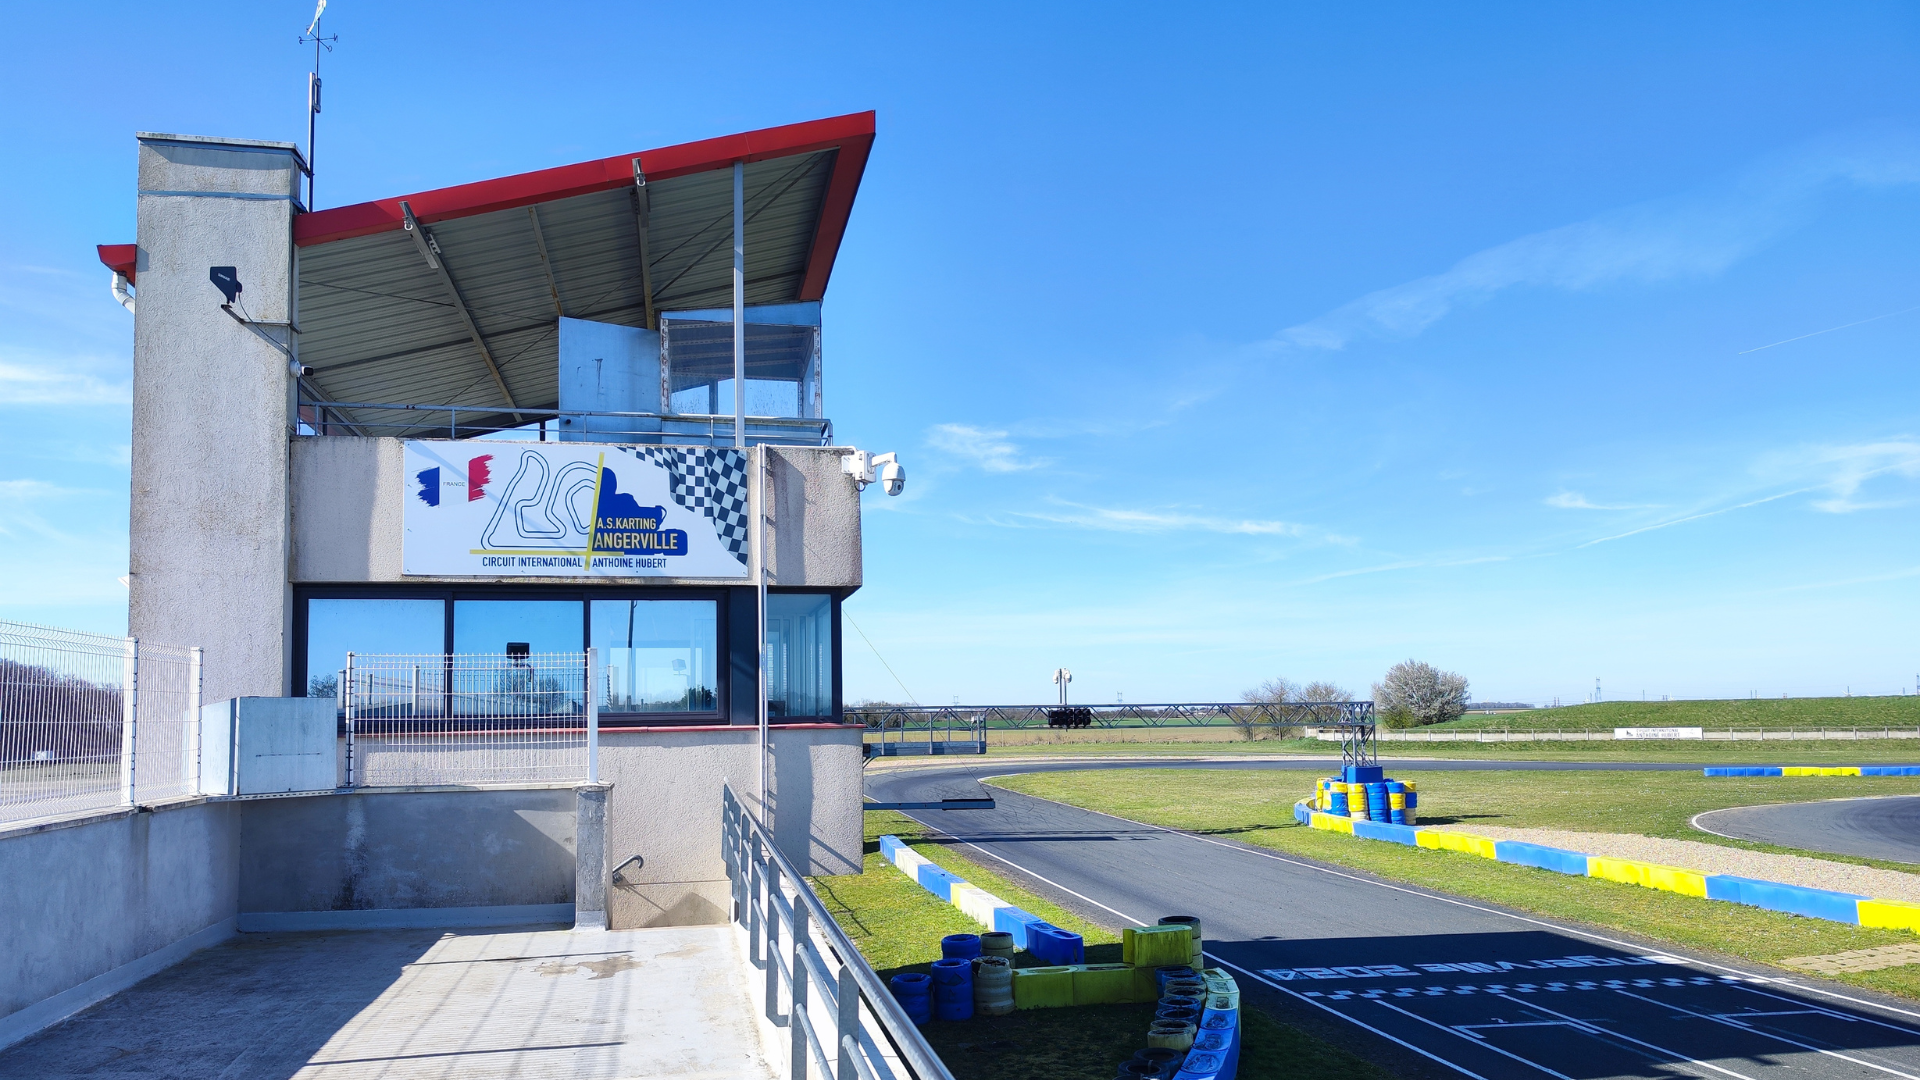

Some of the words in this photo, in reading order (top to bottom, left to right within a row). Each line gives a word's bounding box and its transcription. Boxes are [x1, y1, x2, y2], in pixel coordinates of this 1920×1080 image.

[442, 480, 466, 488] FRANCE
[597, 517, 656, 530] A.S.KARTING
[594, 532, 678, 549] ANGERVILLE
[482, 557, 515, 568] CIRCUIT
[517, 557, 582, 568] INTERNATIONAL
[592, 558, 634, 568] ANTHOINE
[635, 558, 667, 568] HUBERT
[1255, 964, 1421, 981] 2024
